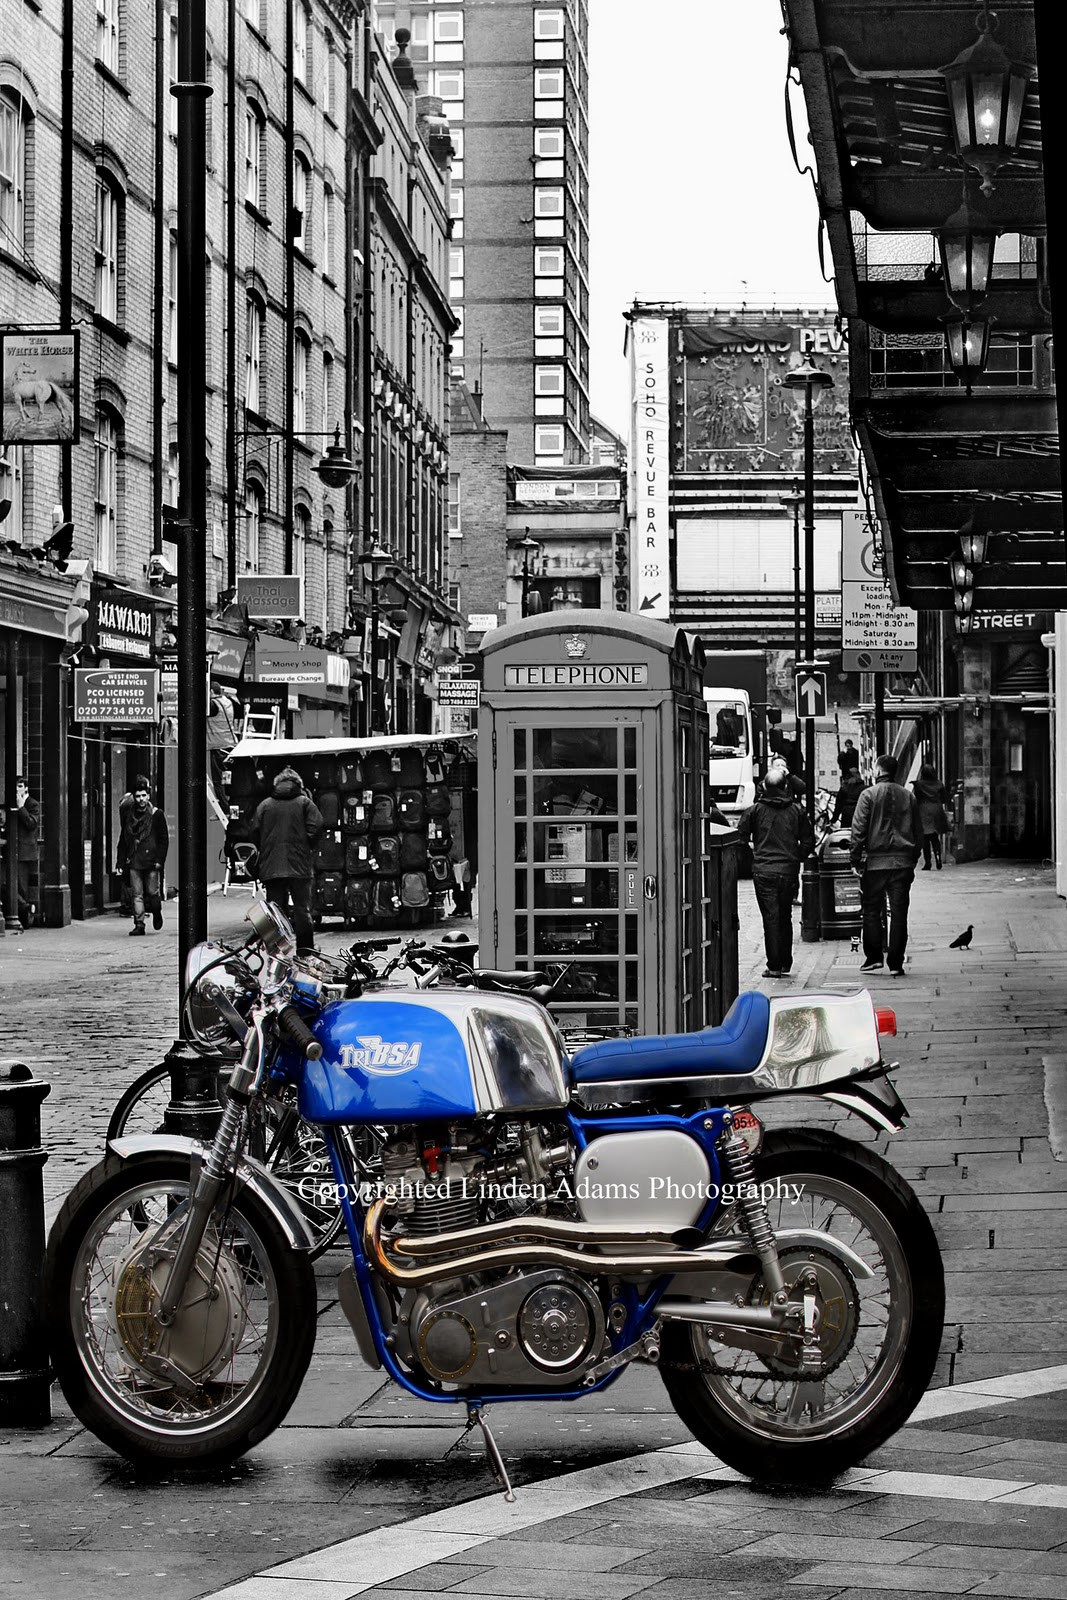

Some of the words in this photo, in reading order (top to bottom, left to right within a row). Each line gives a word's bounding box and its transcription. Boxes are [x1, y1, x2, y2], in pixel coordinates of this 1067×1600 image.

[40, 346, 74, 356] HORSE
[645, 363, 656, 417] SOHO
[646, 431, 656, 496] REVUE
[646, 508, 656, 548] BAR
[256, 586, 281, 596] Thai
[241, 596, 296, 607] Massage
[97, 600, 151, 637] MAWARDI
[876, 612, 908, 620] Midnight
[972, 613, 1036, 629] STREET
[845, 620, 878, 628] Midnight
[845, 639, 878, 647] Midnight
[302, 660, 322, 668] Shop
[437, 666, 460, 674] SNOG
[510, 666, 642, 684] TELEPHONE
[440, 682, 477, 690] RELAXATION
[87, 689, 105, 697] PCO
[106, 689, 144, 697] LICENSED
[78, 707, 97, 715] 020
[99, 707, 125, 715] 7734
[128, 707, 153, 715] 8970
[733, 1116, 747, 1130] 05
